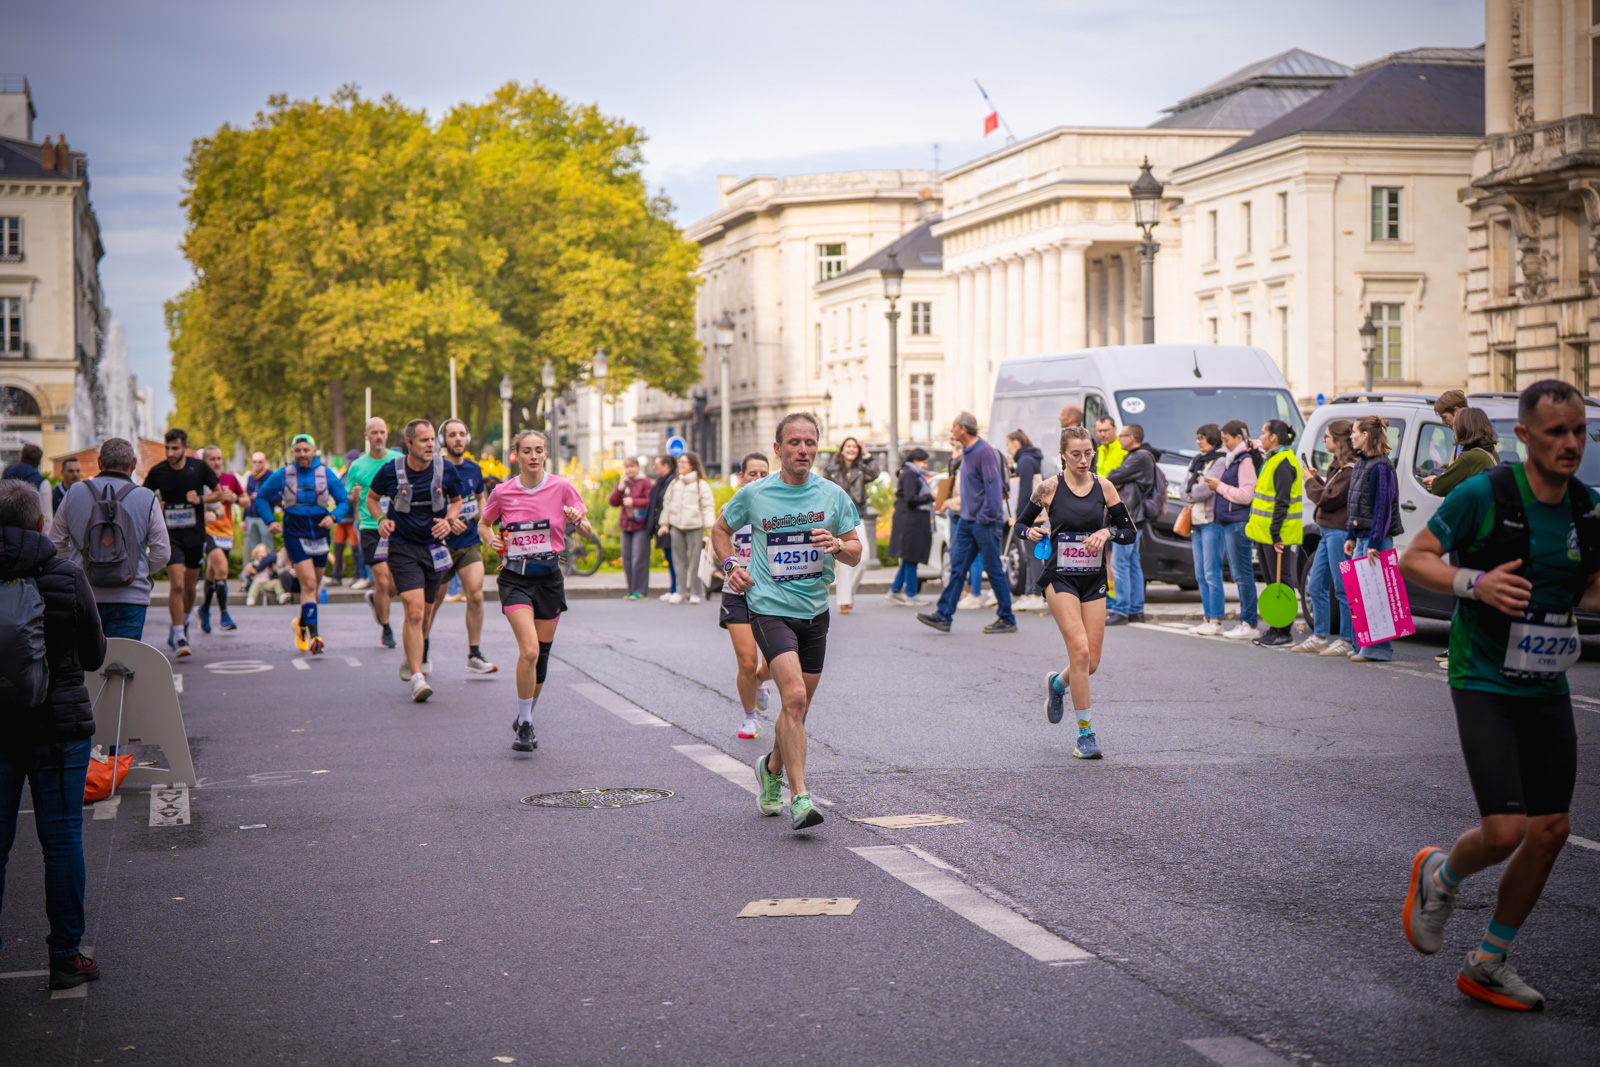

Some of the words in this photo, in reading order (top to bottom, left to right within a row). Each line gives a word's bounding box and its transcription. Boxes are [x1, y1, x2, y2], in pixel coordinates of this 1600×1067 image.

[459, 504, 476, 514] 453
[762, 518, 772, 531] Le
[772, 514, 796, 529] Souffle
[796, 512, 807, 525] du
[807, 511, 825, 523] Gers
[511, 533, 546, 547] 42382
[773, 549, 819, 565] 42510
[1517, 634, 1577, 656] 42279
[1538, 657, 1557, 665] CYRIL
